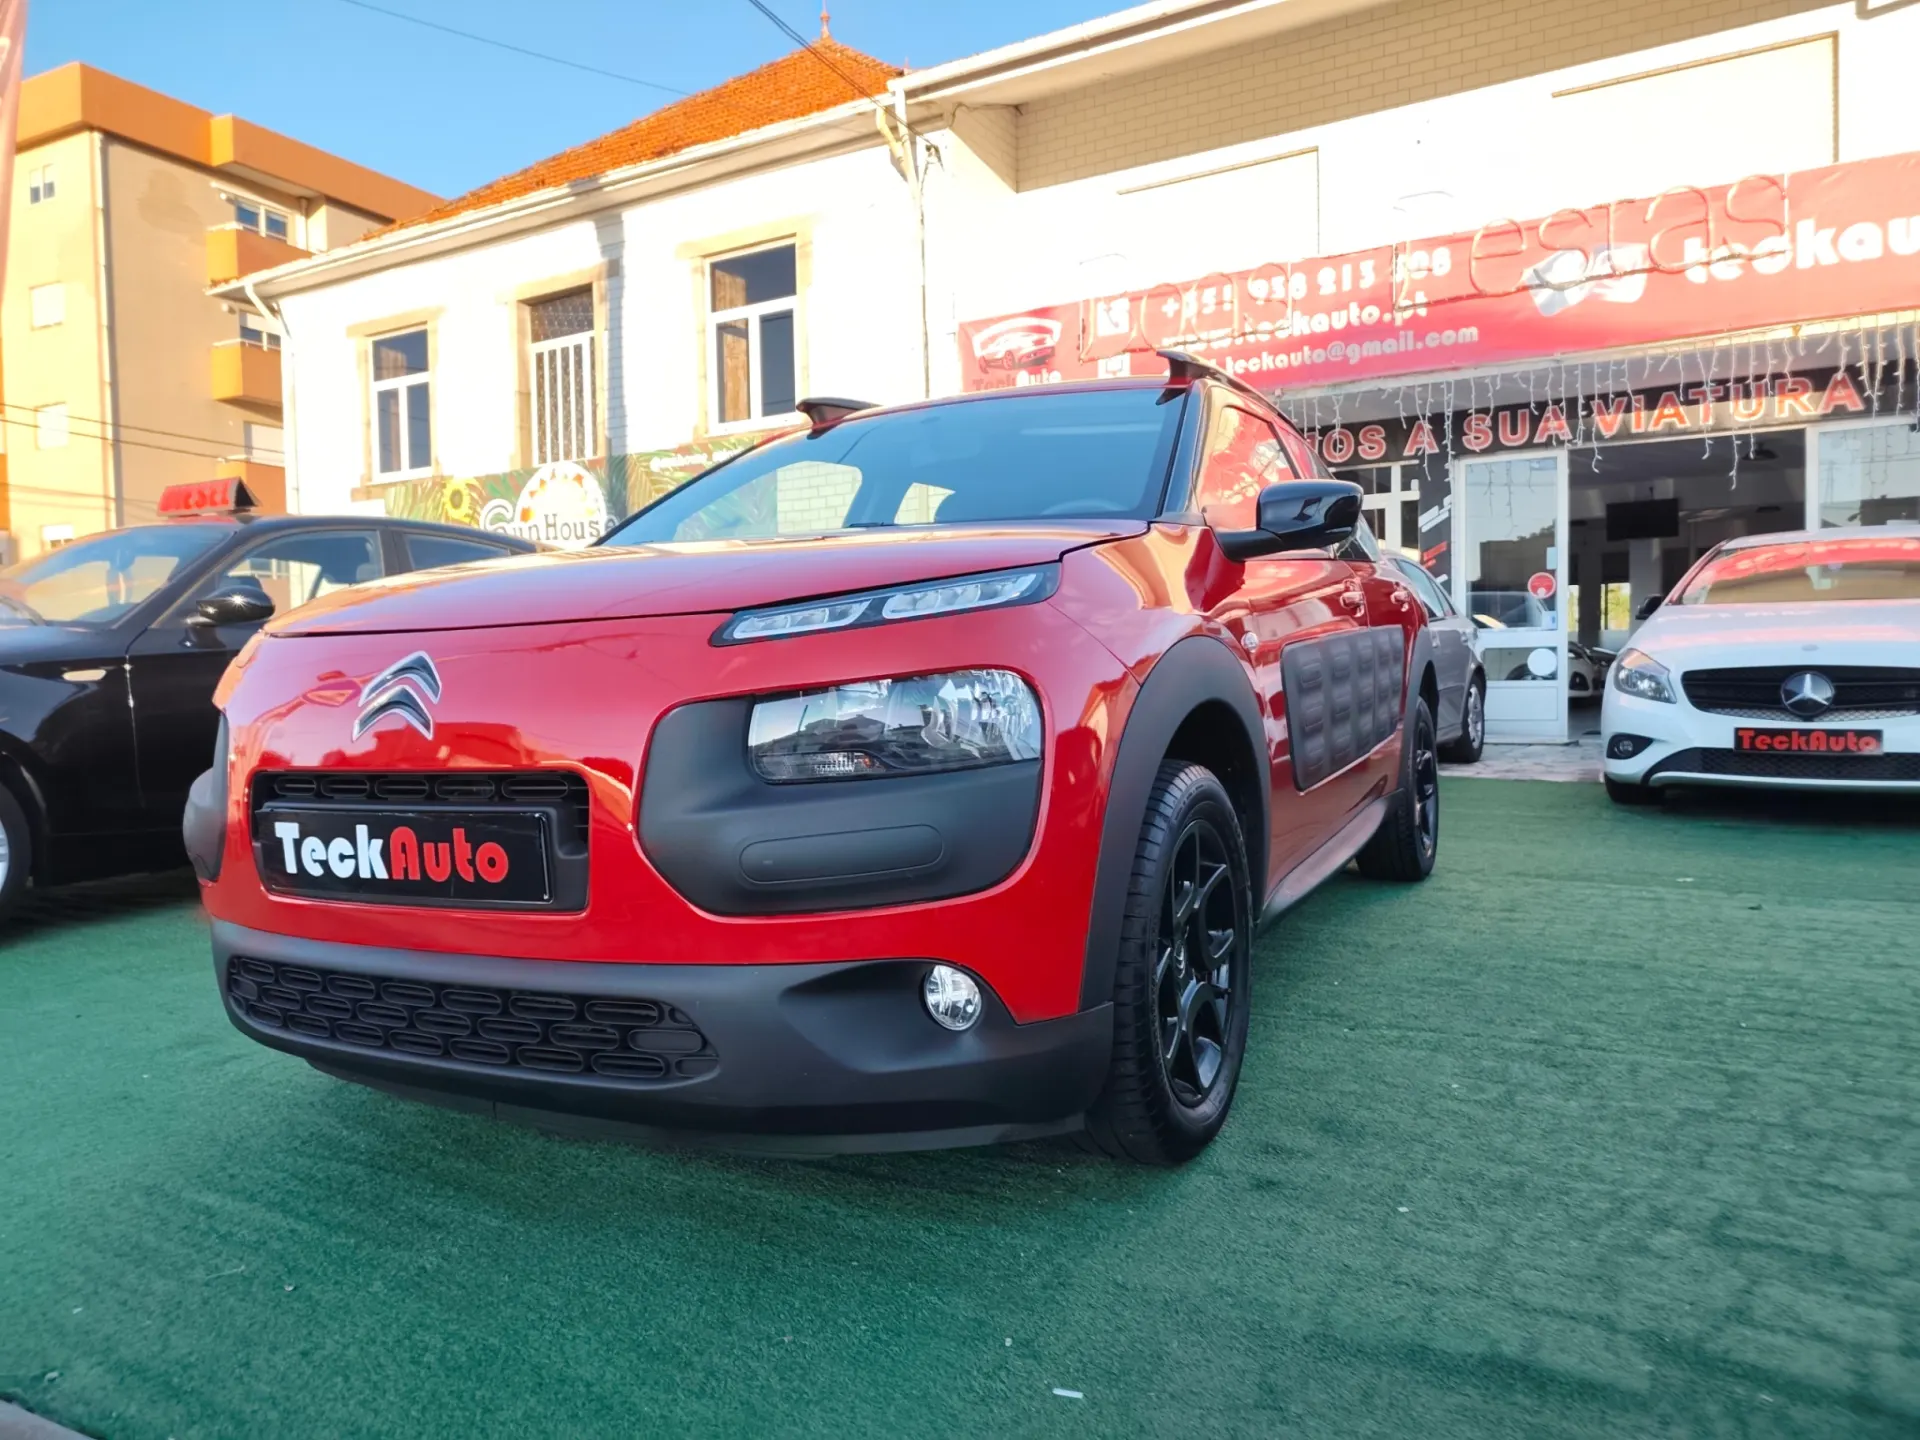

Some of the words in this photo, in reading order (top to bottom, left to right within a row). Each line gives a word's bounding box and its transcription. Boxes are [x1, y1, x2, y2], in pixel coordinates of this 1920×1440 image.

[1684, 215, 1920, 283] teckau
[1403, 421, 1440, 457] A
[1462, 404, 1574, 451] SUA
[1592, 372, 1865, 438] VIATURA
[1738, 730, 1878, 751] TeckAuto
[274, 822, 509, 883] TeckAuto
